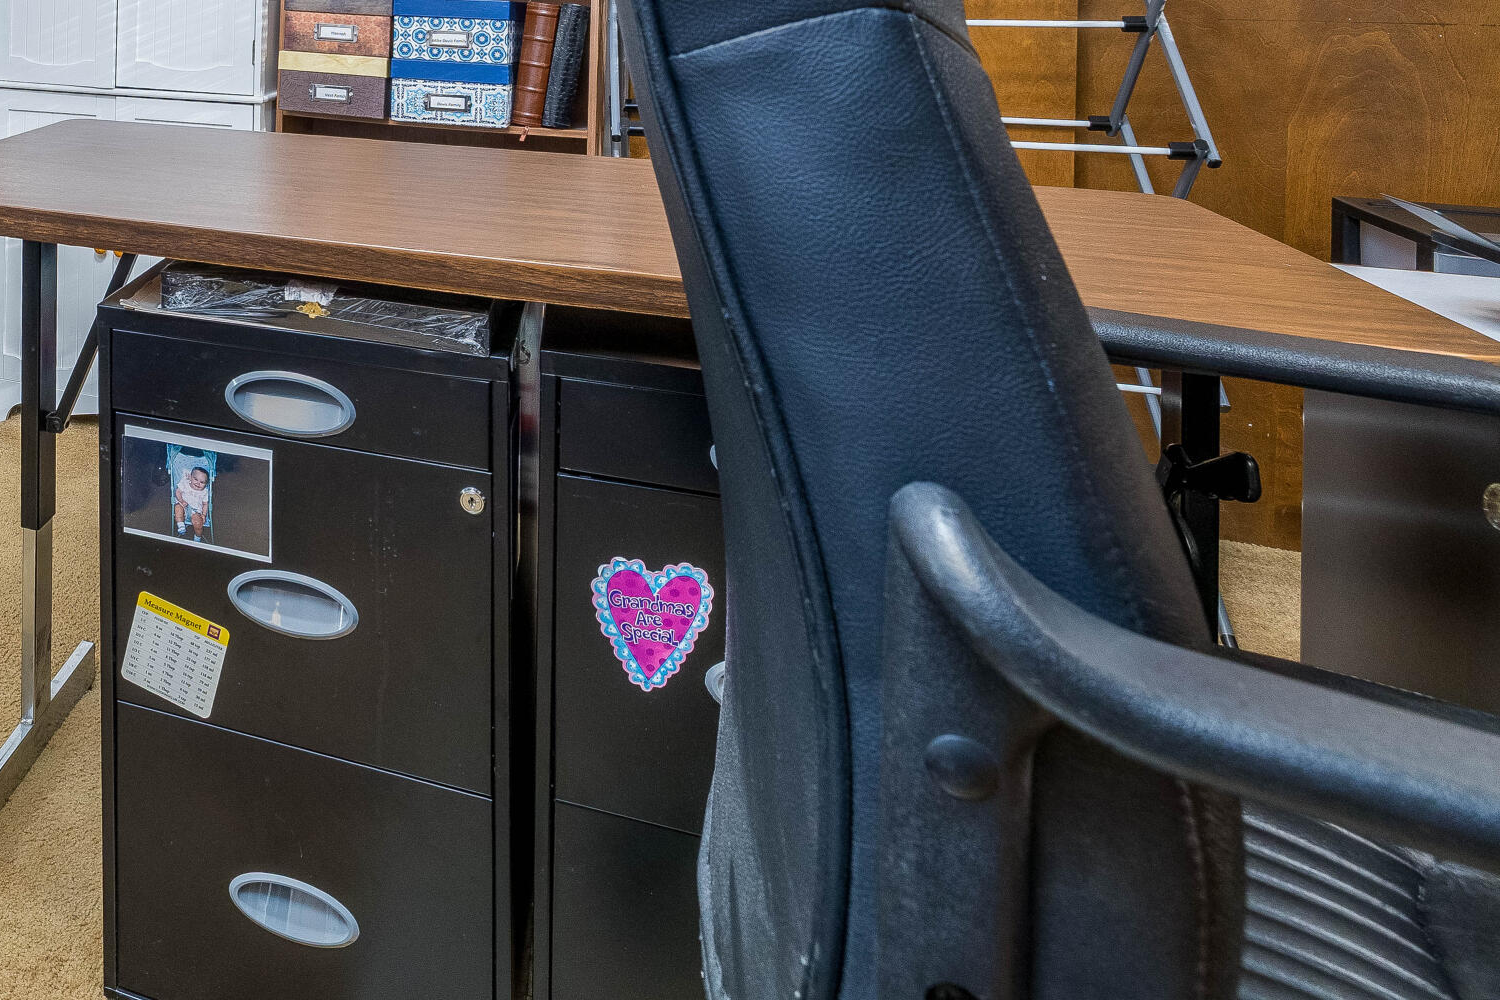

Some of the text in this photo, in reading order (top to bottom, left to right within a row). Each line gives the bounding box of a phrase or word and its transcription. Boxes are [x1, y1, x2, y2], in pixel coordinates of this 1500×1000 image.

[144, 599, 202, 630] Measure Magnet
[609, 589, 695, 618] Grandmas
[636, 610, 662, 626] Are
[621, 622, 679, 646] Special
